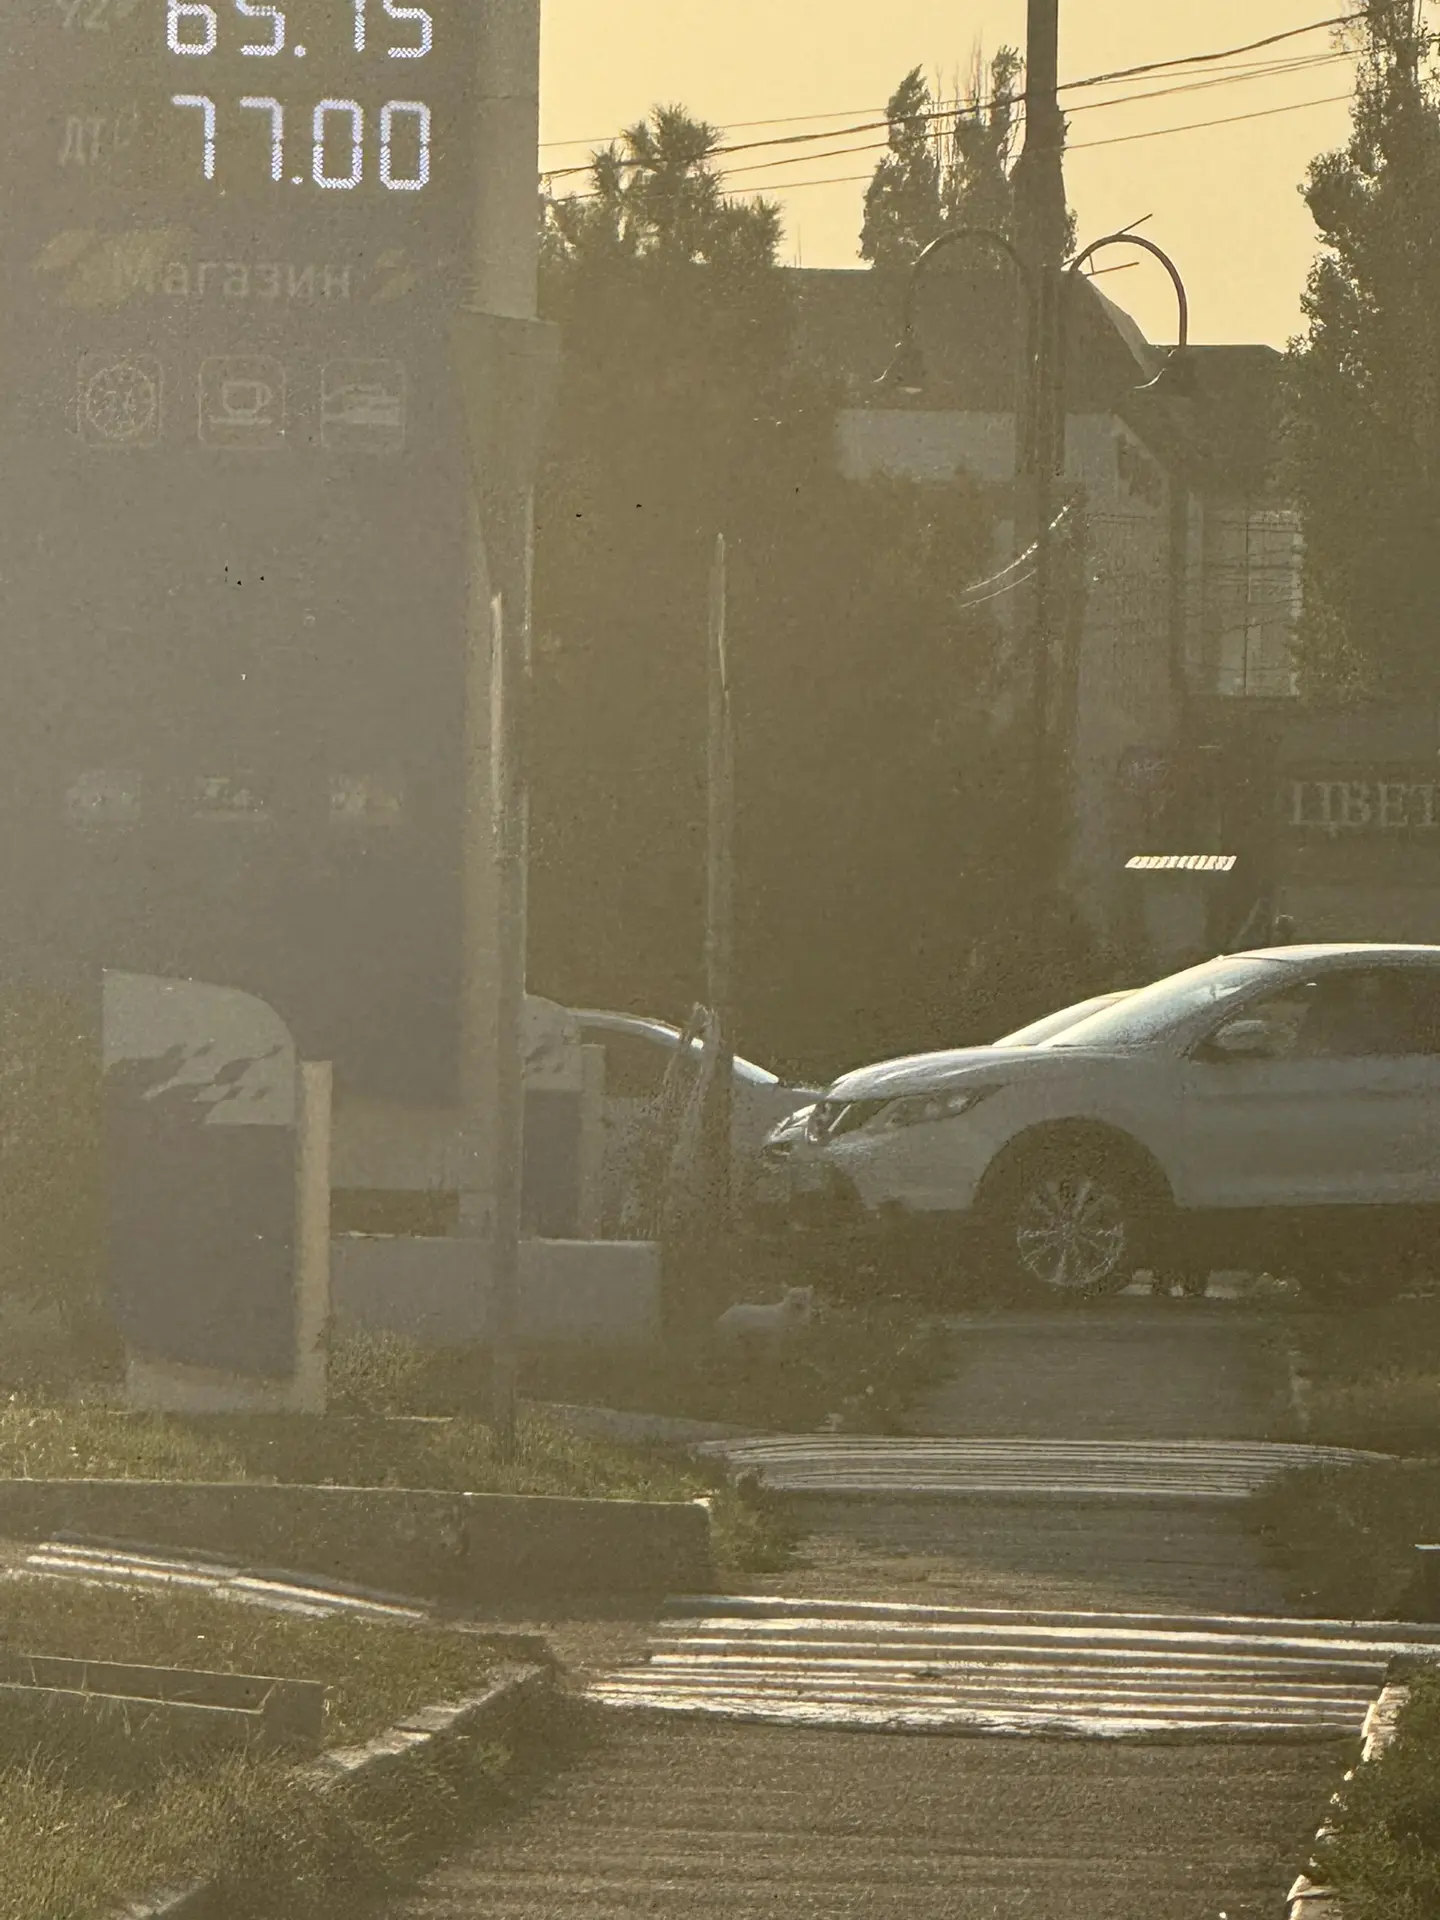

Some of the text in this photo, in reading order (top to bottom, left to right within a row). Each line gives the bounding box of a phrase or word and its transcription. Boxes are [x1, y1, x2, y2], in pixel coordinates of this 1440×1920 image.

[57, 95, 432, 191] ДТ 77.00
[112, 246, 352, 300] Магазин
